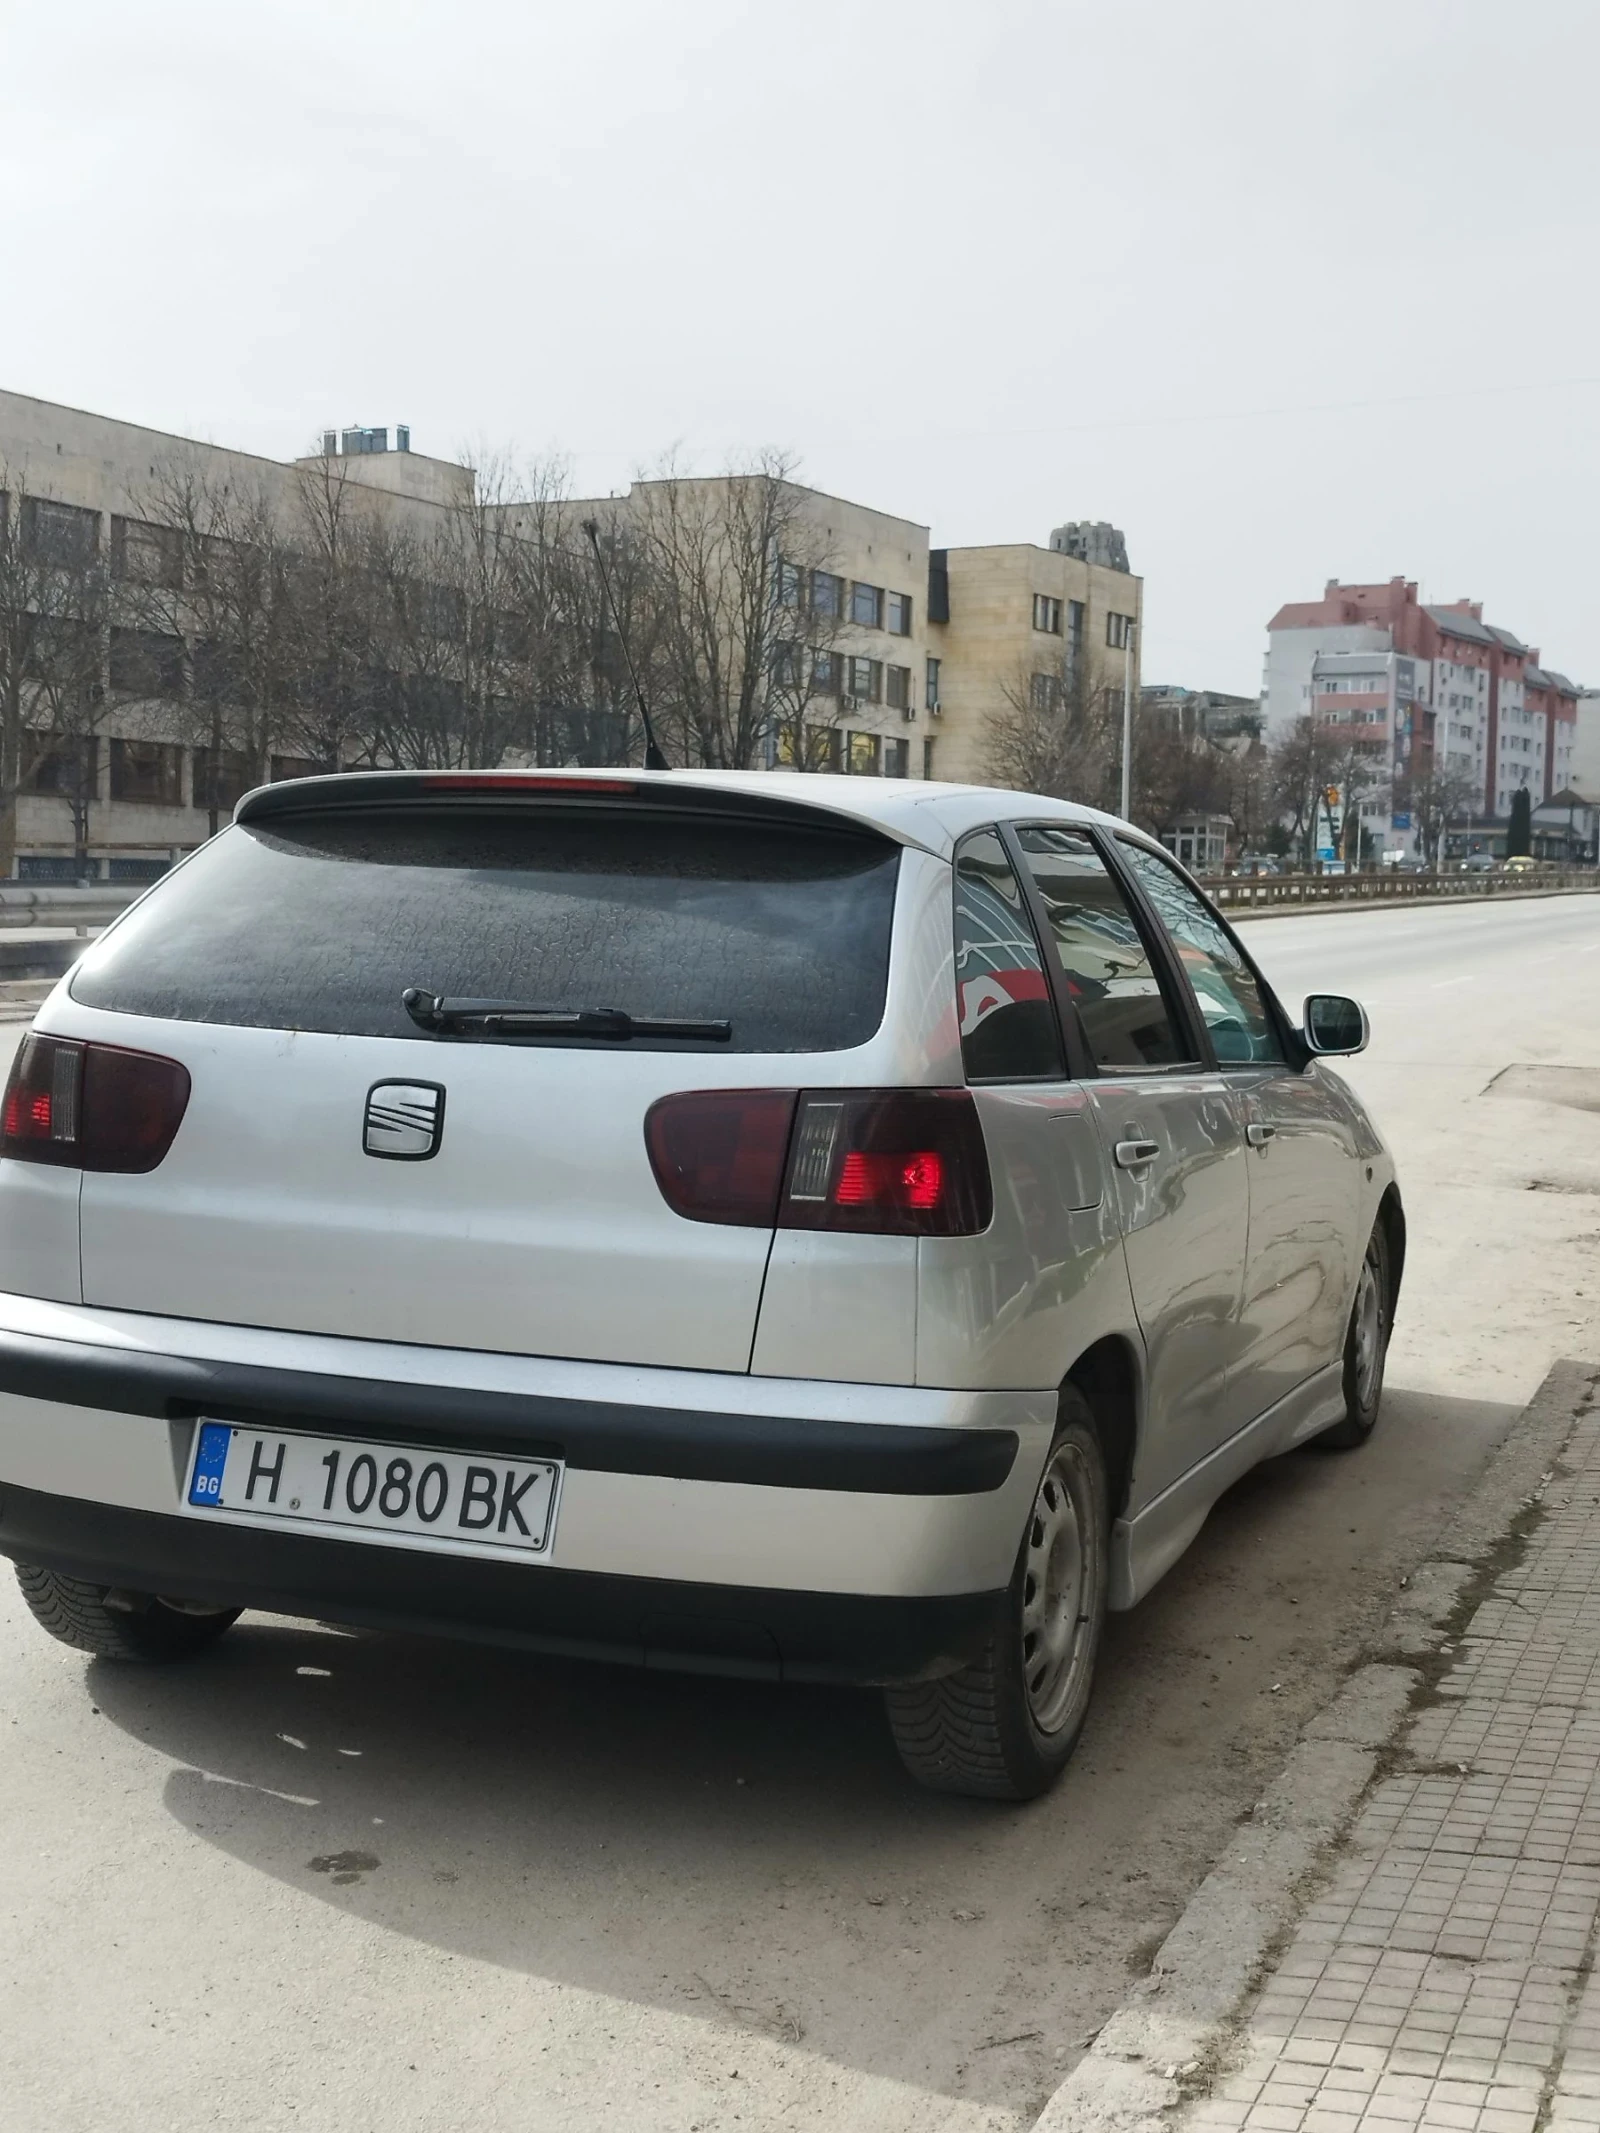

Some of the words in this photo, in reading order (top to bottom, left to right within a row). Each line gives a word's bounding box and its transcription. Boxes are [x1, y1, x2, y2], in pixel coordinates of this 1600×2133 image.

[195, 1475, 218, 1495] BG
[245, 1441, 286, 1503] H
[322, 1450, 448, 1523] 1080
[458, 1466, 539, 1536] BK
